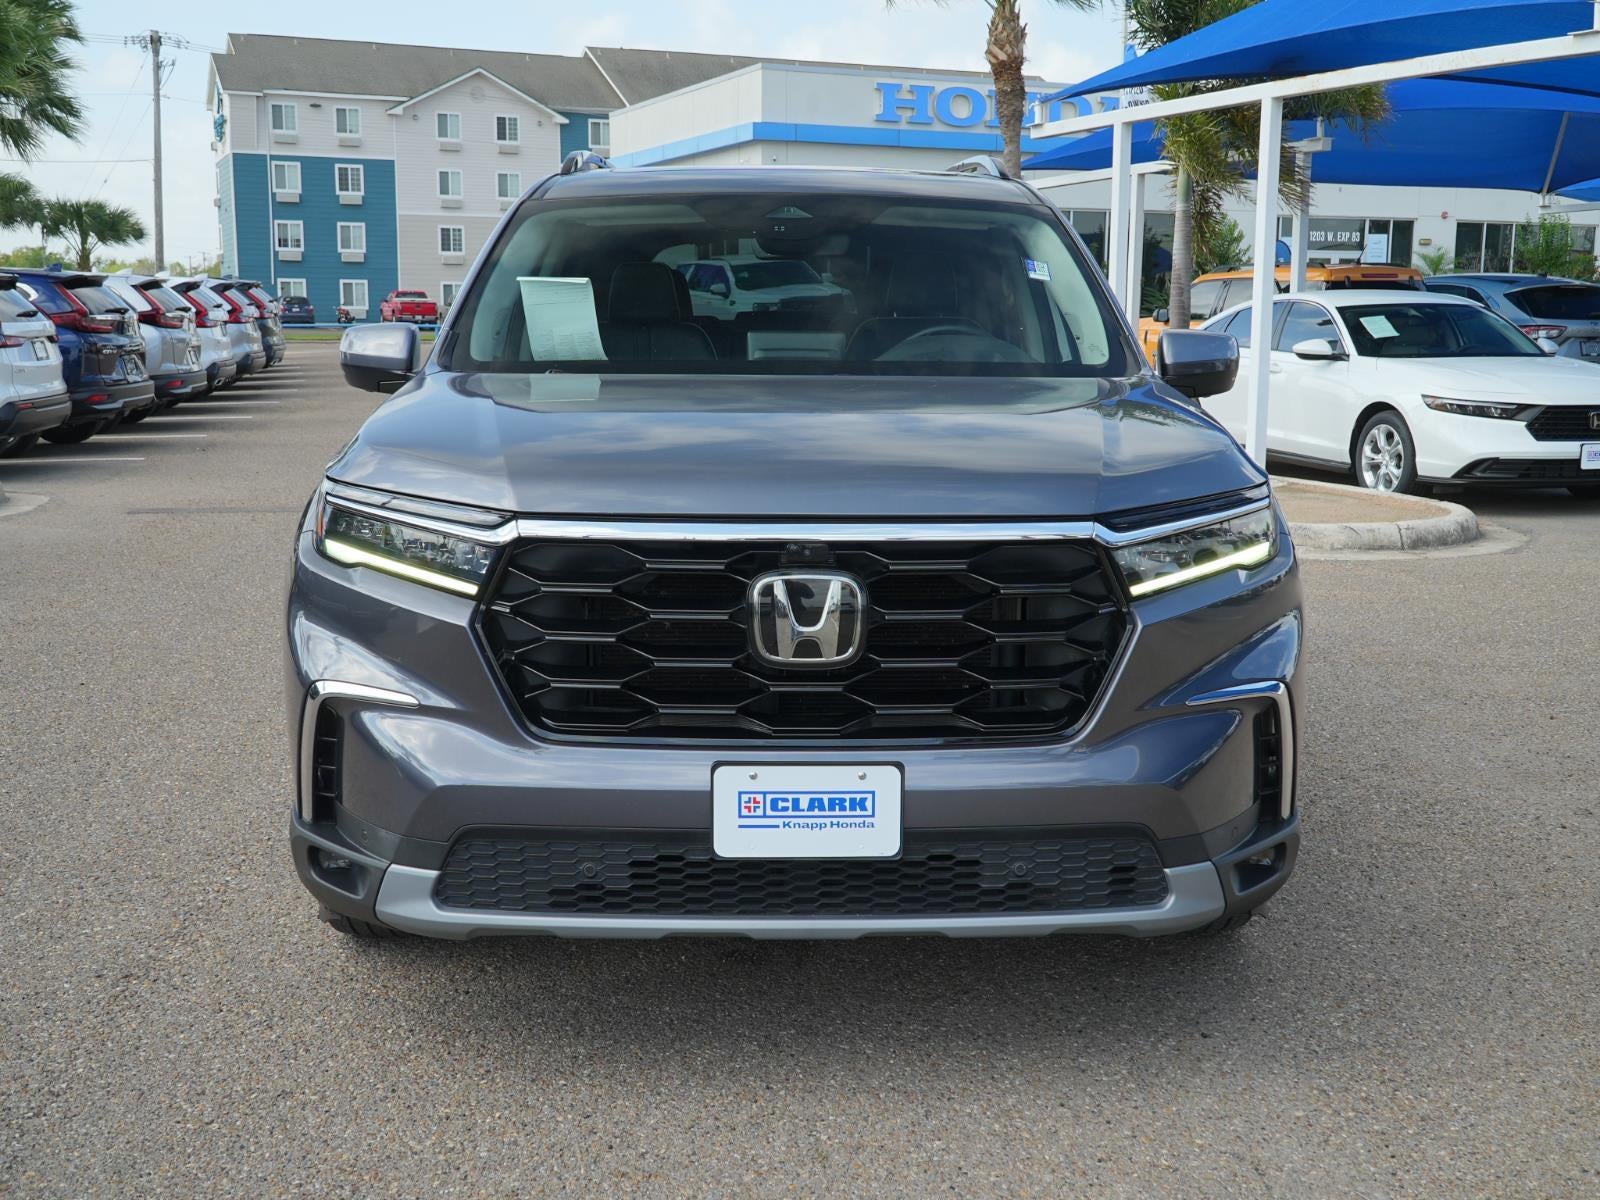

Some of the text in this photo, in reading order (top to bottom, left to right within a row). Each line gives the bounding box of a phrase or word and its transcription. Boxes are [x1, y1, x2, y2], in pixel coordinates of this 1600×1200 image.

[1309, 231, 1325, 242] 1203
[1327, 232, 1335, 242] W.
[1337, 232, 1350, 242] EXP
[769, 797, 868, 812] CLARK
[782, 820, 875, 830] Knapp Honda
